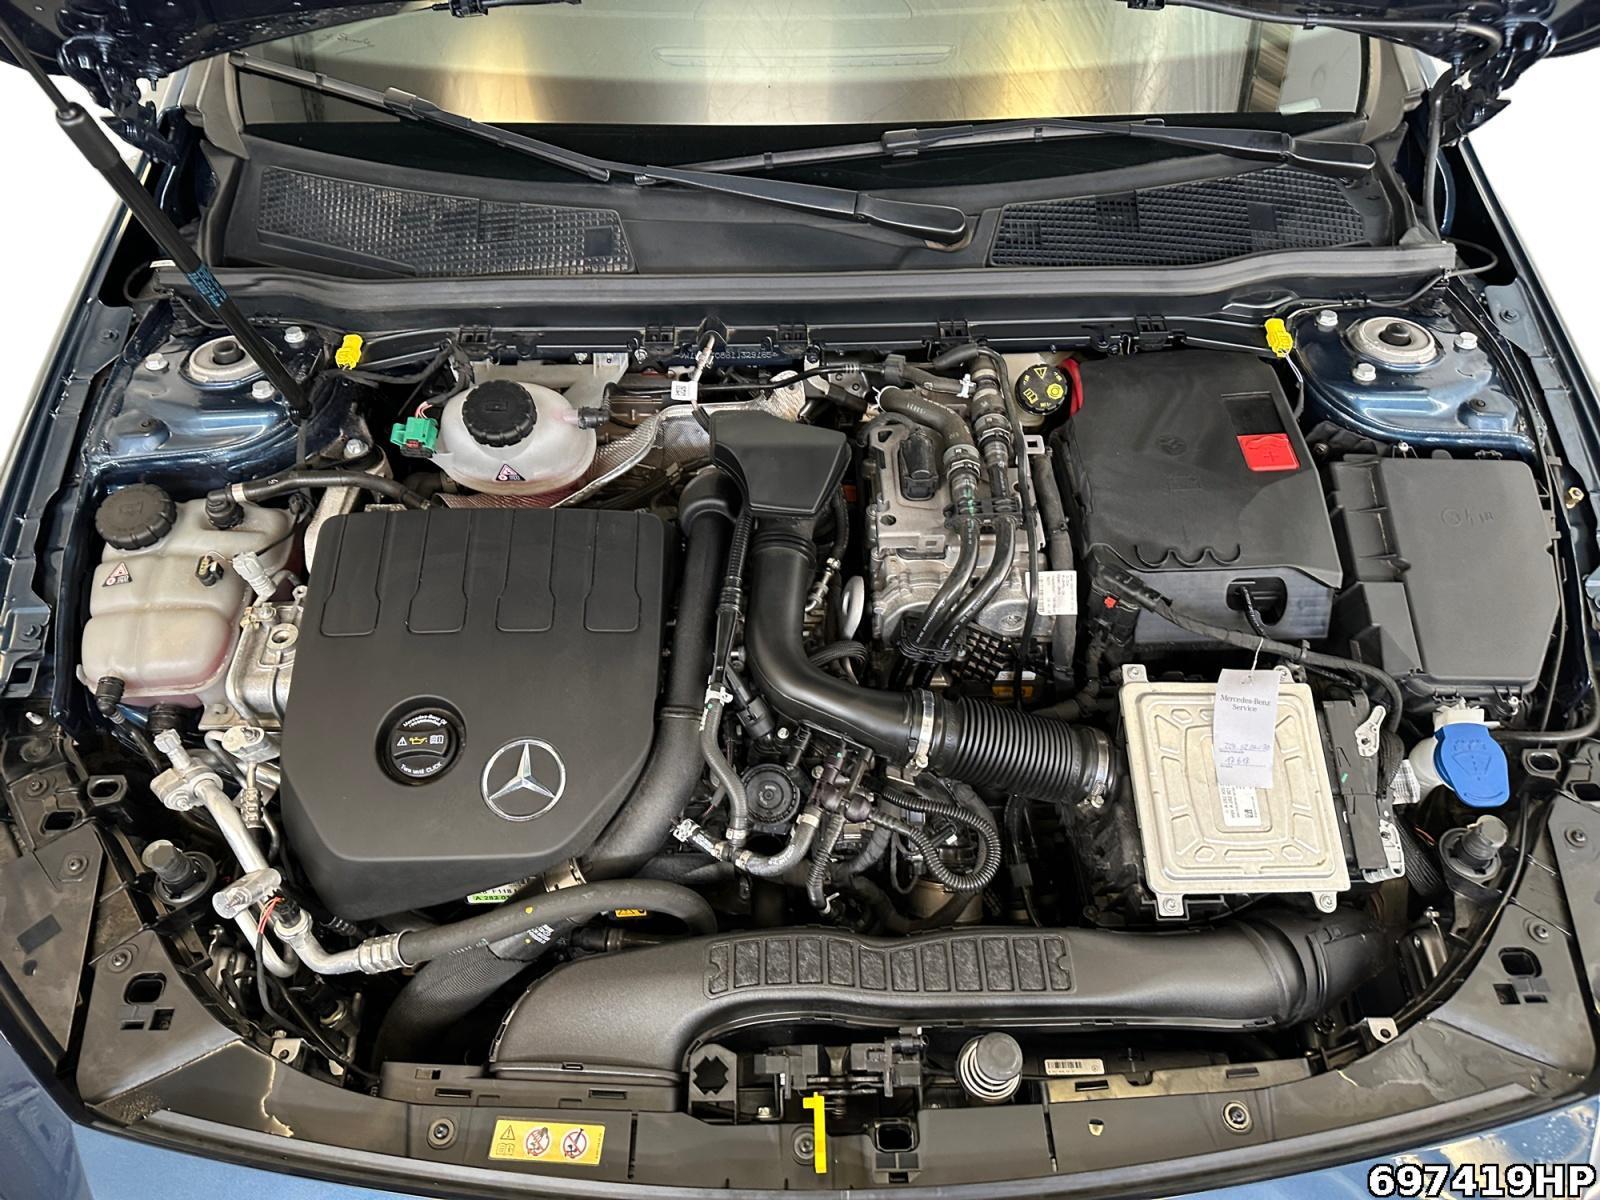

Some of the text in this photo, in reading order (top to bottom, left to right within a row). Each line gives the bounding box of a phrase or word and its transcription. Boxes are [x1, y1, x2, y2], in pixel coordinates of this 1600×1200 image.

[1220, 694, 1270, 706] Mercedes-Benz
[1232, 704, 1258, 712] Service
[400, 763, 412, 773] Turn
[426, 761, 442, 773] CLICK
